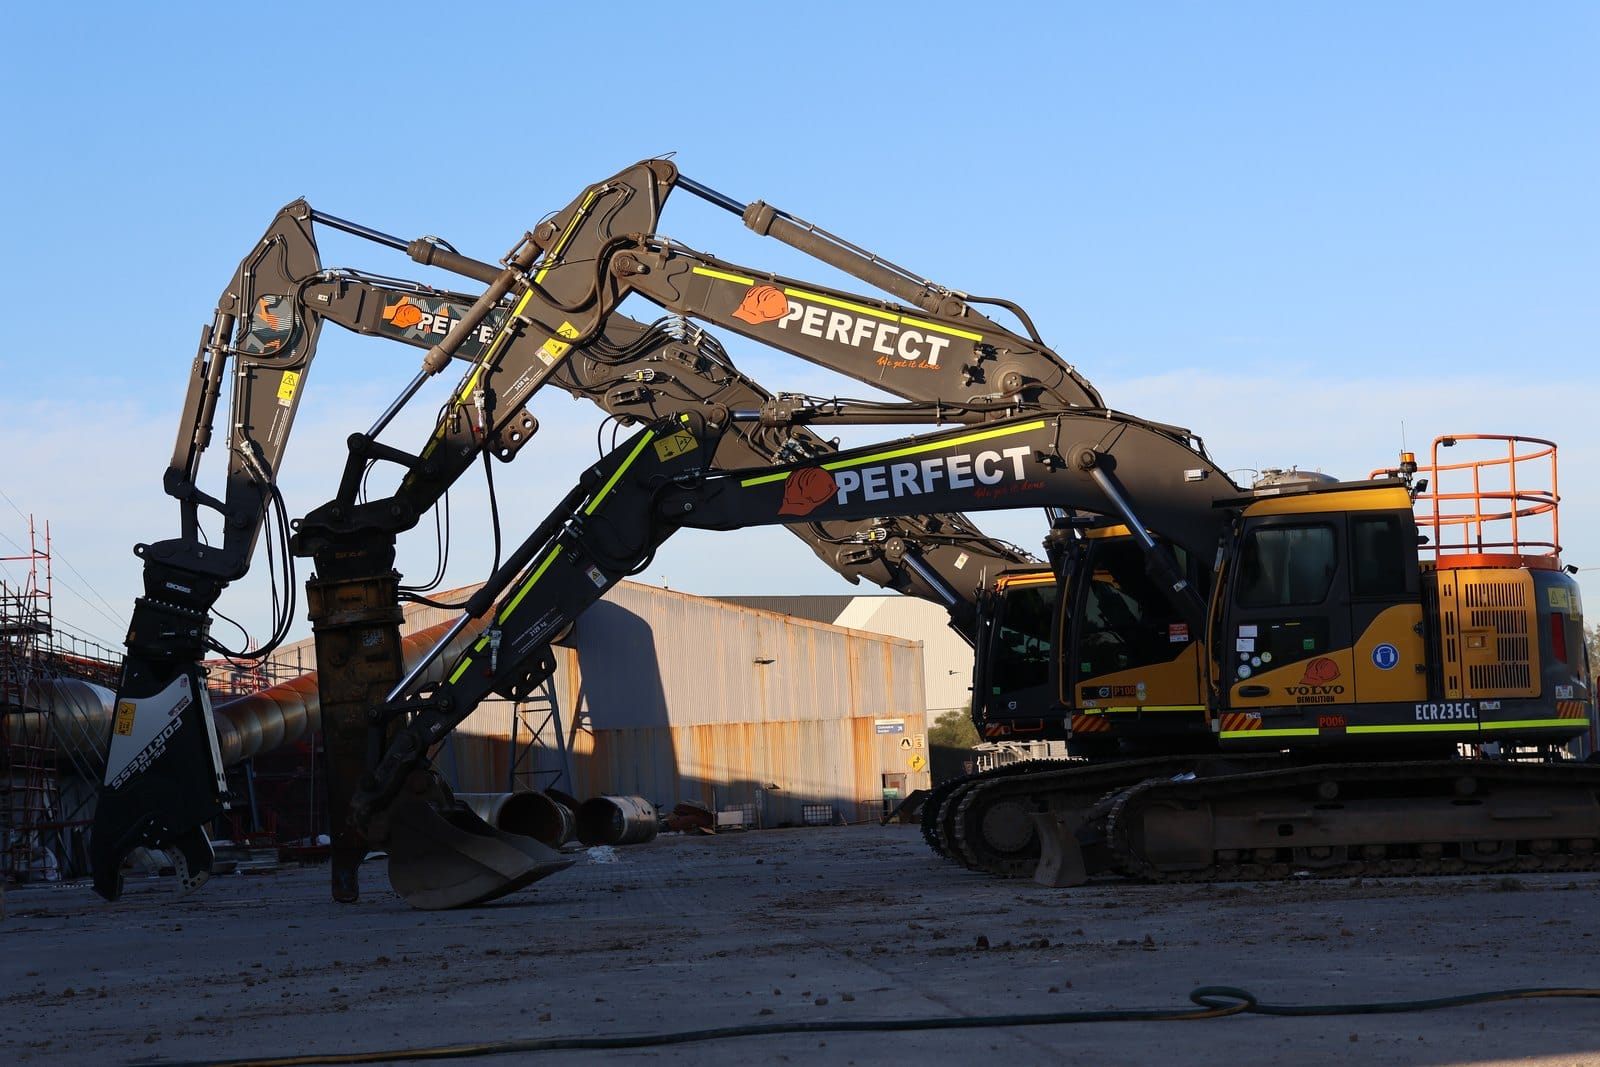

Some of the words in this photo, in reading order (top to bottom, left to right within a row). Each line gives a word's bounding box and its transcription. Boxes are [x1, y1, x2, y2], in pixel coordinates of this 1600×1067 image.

[777, 301, 951, 366] PERFECT
[893, 359, 907, 368] get
[917, 359, 941, 370] done
[834, 446, 1031, 505] PERFECT
[1113, 686, 1136, 696] P100
[1284, 685, 1345, 696] VOLVO
[1296, 695, 1335, 703] DEMOLITION
[1319, 716, 1345, 728] P006
[112, 717, 183, 790] FORTRESS
